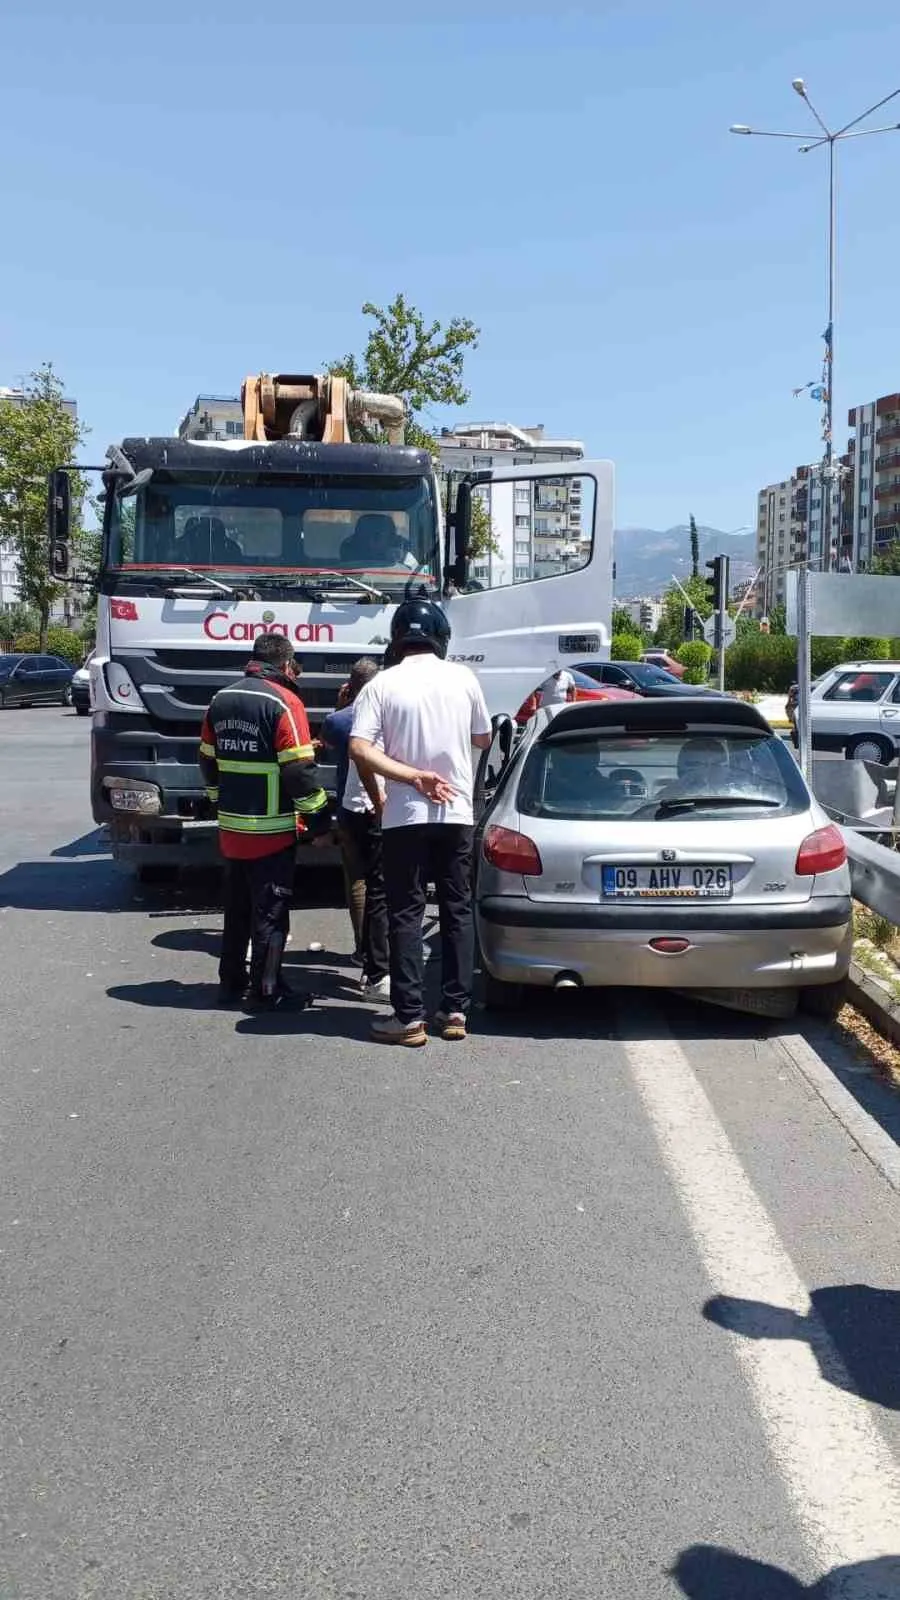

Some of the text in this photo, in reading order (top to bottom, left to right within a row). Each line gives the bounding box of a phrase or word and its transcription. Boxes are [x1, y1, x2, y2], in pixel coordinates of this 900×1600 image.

[616, 868, 727, 889] 09 AHV 026
